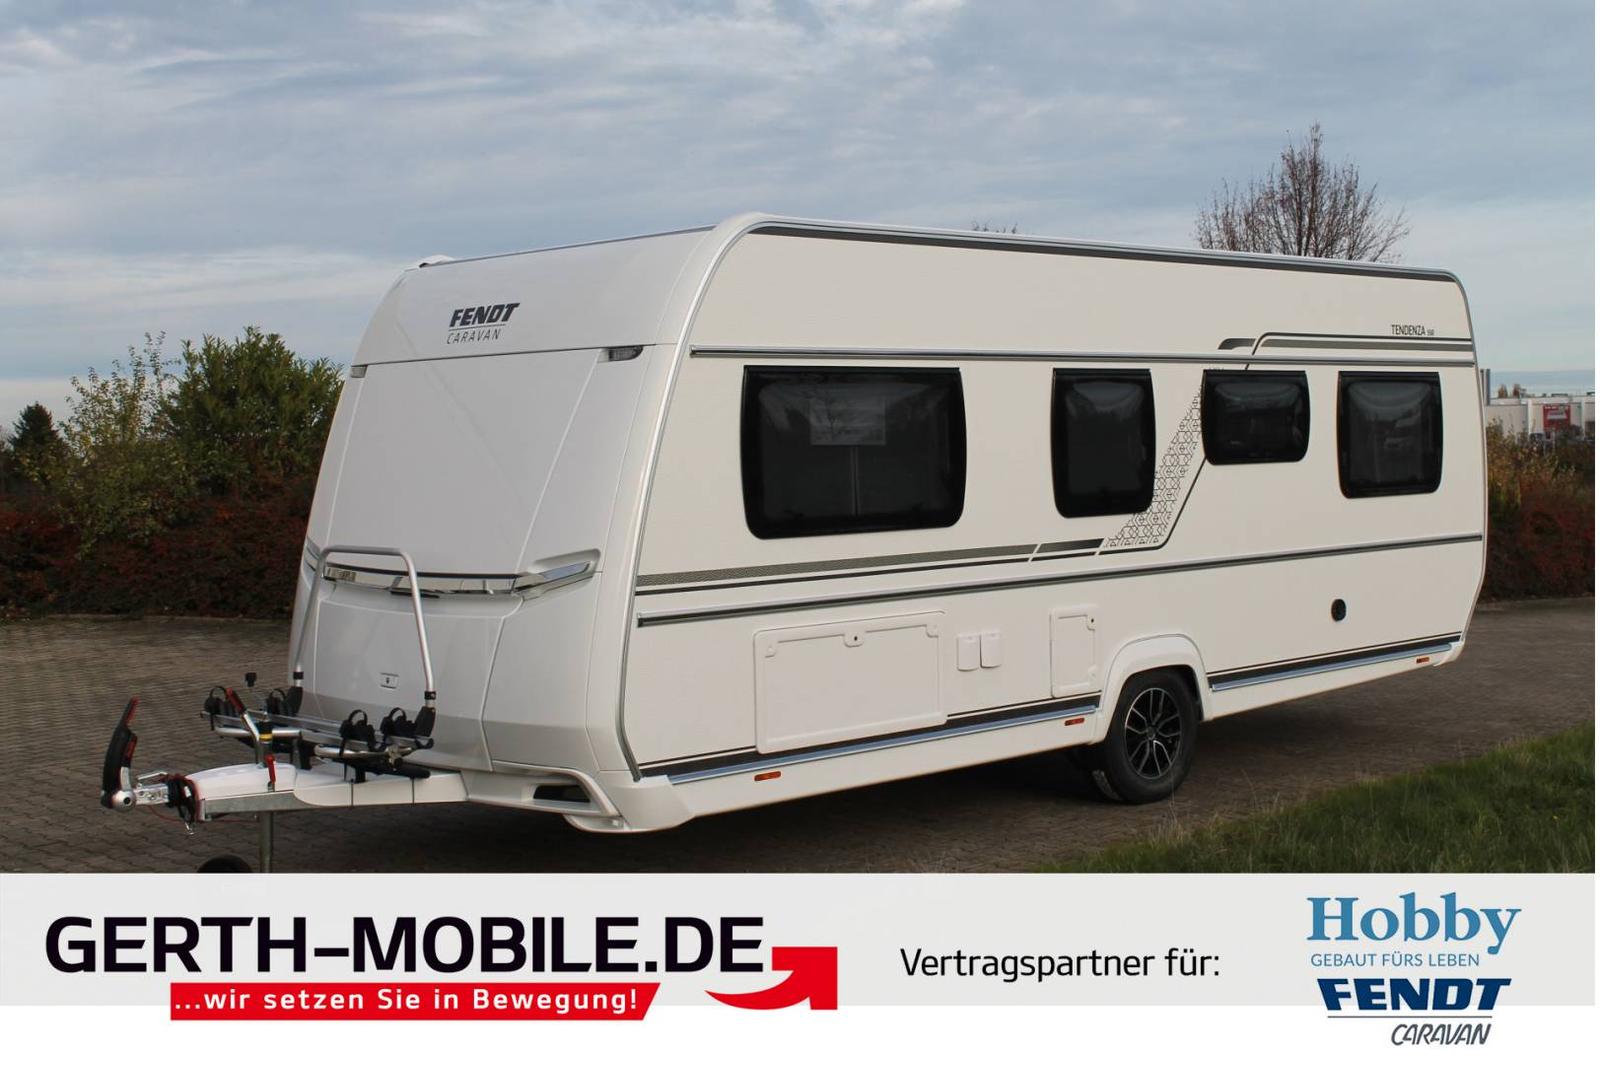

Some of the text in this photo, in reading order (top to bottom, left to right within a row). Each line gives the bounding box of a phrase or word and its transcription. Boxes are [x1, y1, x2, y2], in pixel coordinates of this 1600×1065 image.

[449, 302, 521, 328] FENDT
[446, 328, 502, 345] CARAVAN
[1391, 324, 1426, 336] TENDENZA
